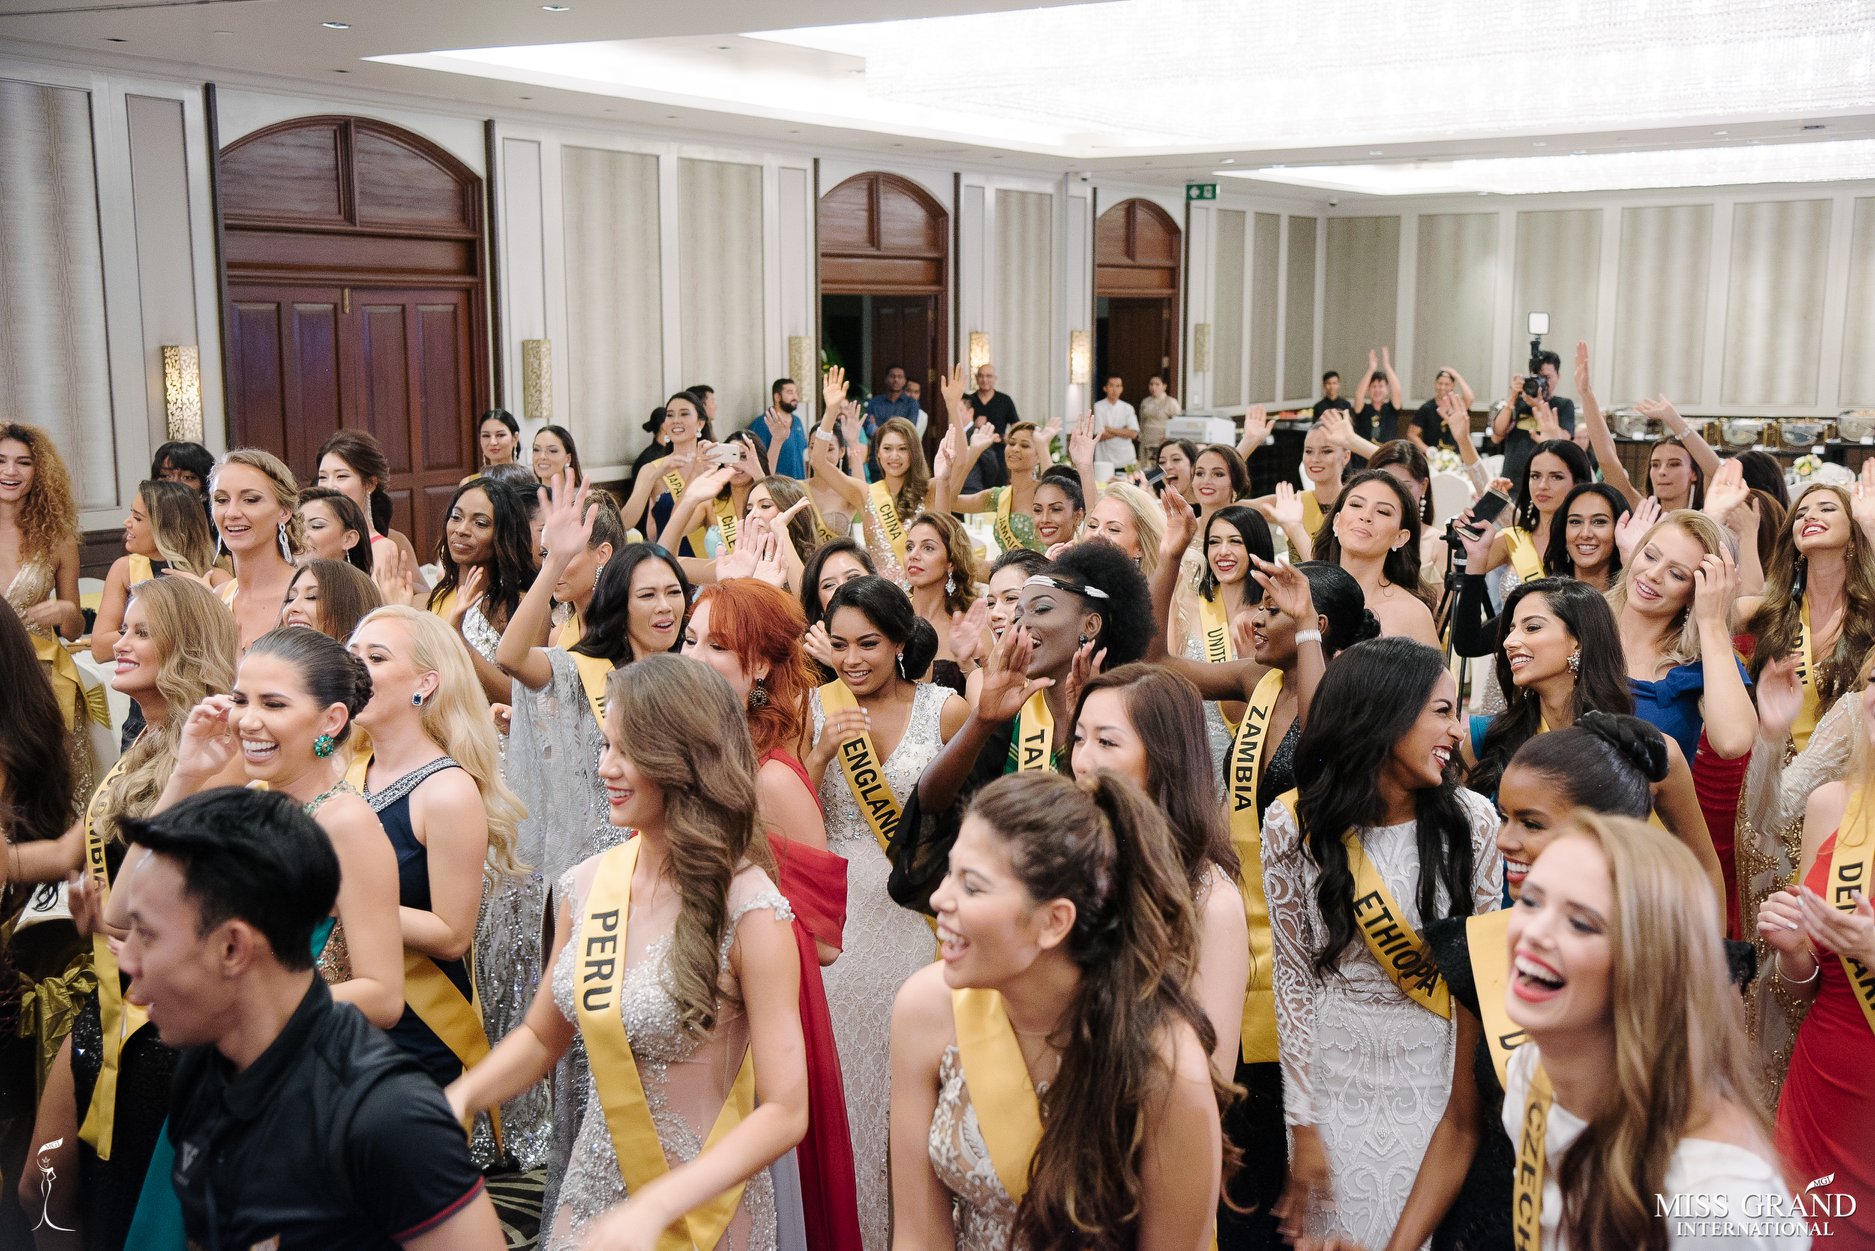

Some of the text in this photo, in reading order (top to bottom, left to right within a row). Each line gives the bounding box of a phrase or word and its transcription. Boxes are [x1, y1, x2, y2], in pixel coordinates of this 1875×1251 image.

[880, 504, 902, 541] CHINA
[1234, 705, 1269, 812] ZAMBIA
[582, 908, 620, 1012] PERU
